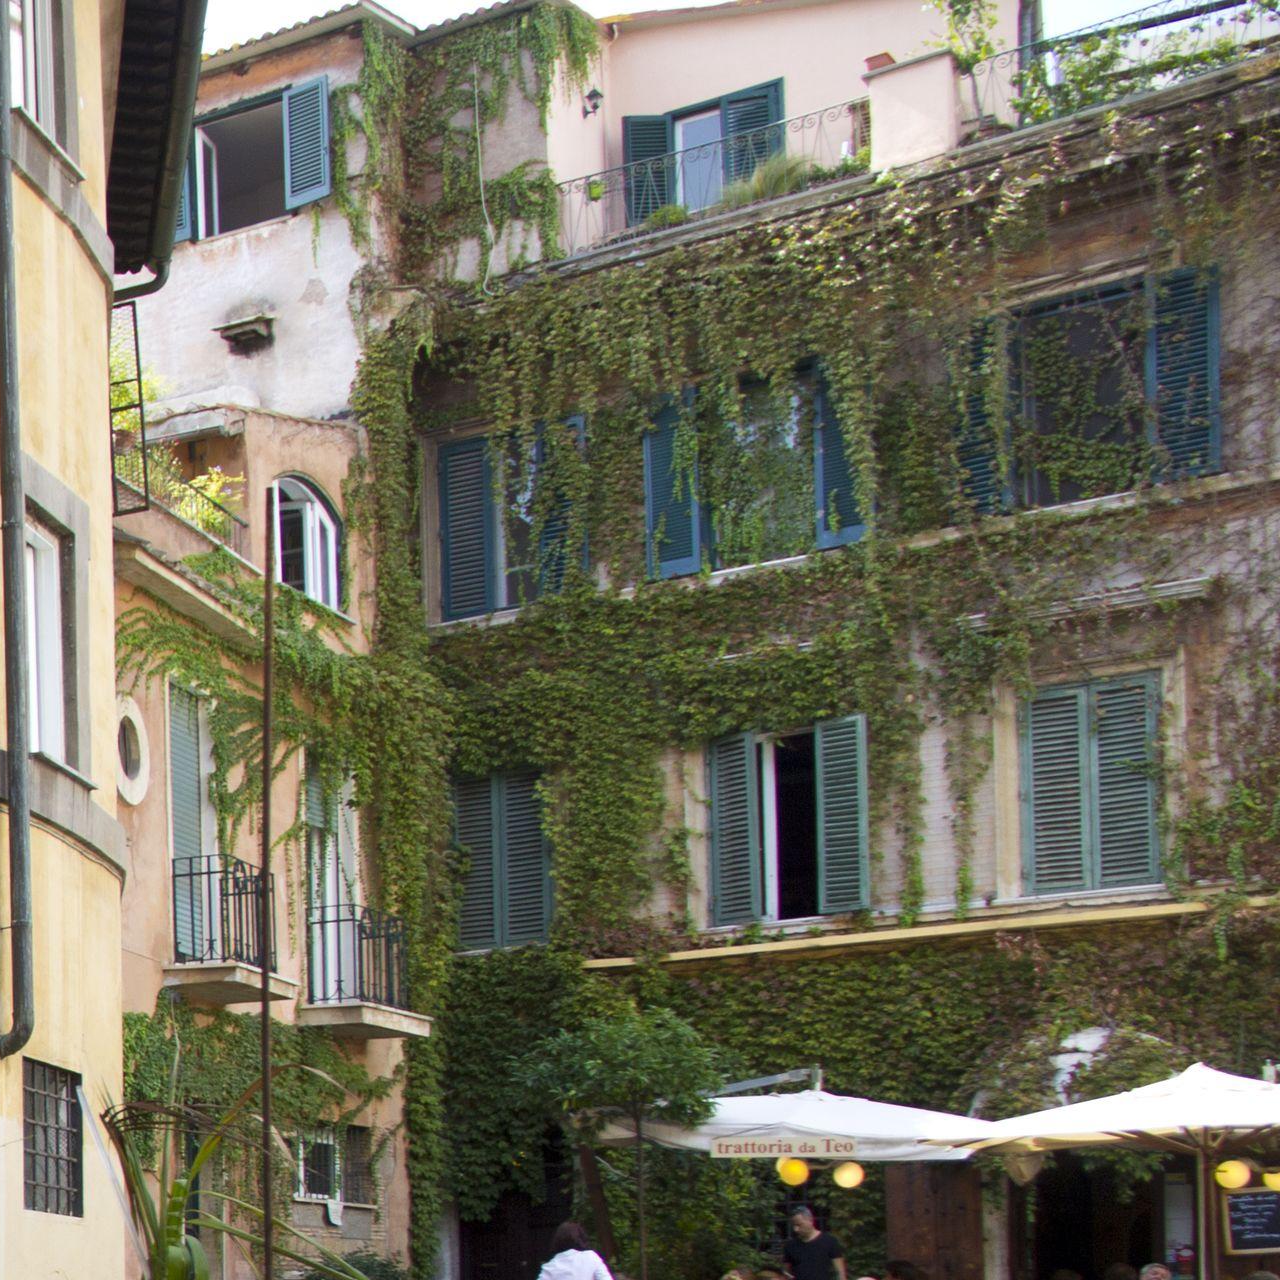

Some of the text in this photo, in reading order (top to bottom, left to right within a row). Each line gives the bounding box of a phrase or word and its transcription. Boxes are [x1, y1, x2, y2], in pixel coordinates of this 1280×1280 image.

[717, 1137, 854, 1154] trattoria da Teo
